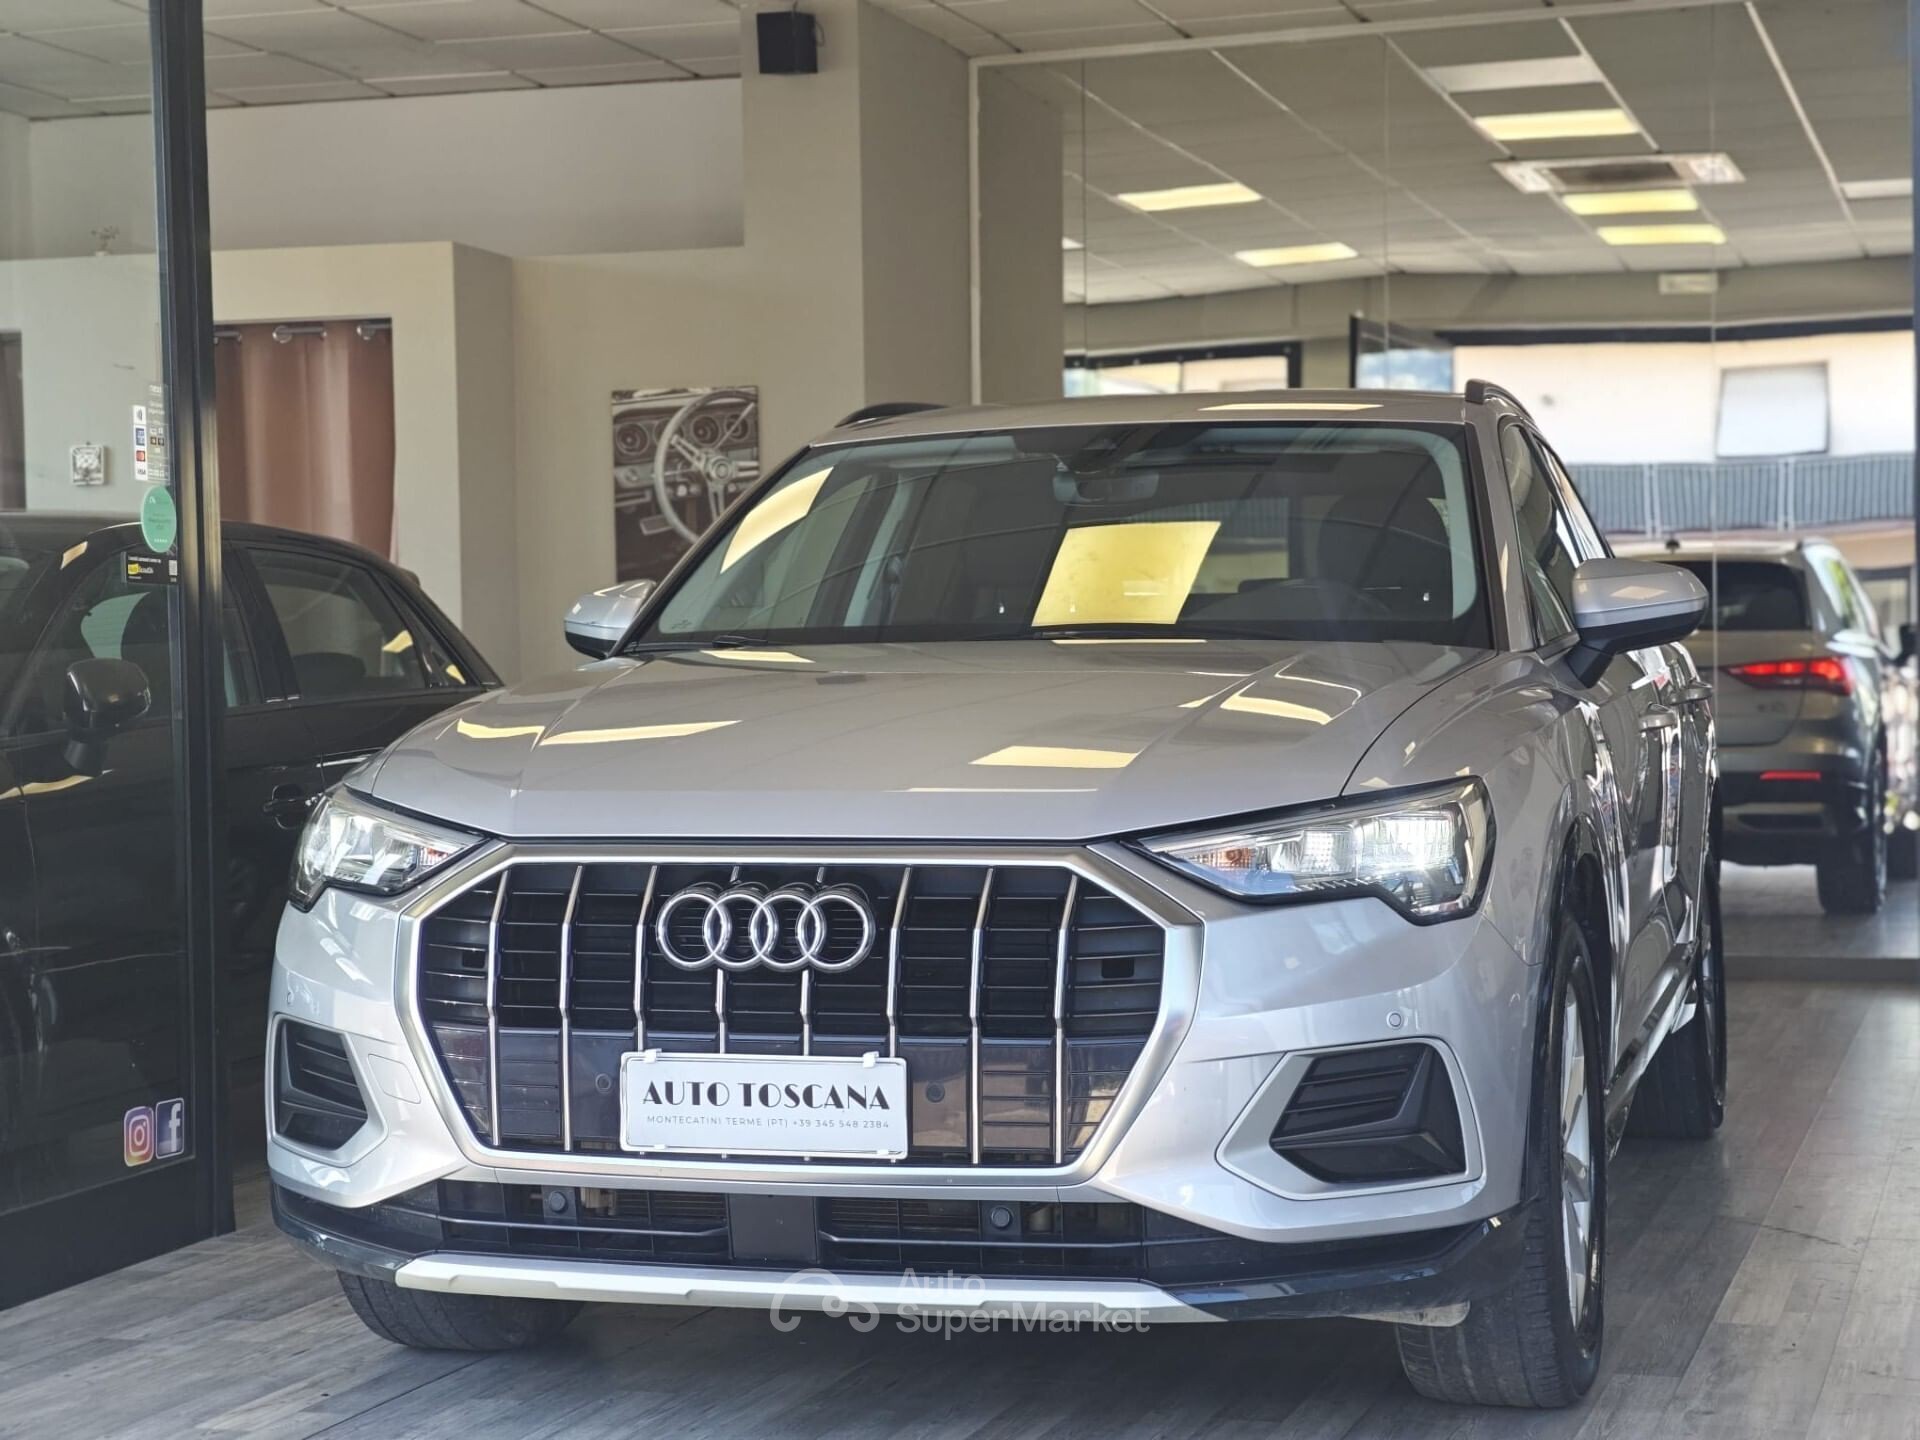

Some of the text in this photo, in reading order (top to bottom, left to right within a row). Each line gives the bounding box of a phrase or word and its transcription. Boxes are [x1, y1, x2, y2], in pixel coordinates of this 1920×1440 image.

[642, 1080, 891, 1111] AUTO TOSCANA
[168, 1102, 182, 1153] f
[647, 1115, 890, 1130] MONTECATINI TERME (PT) +39 345 548 2384
